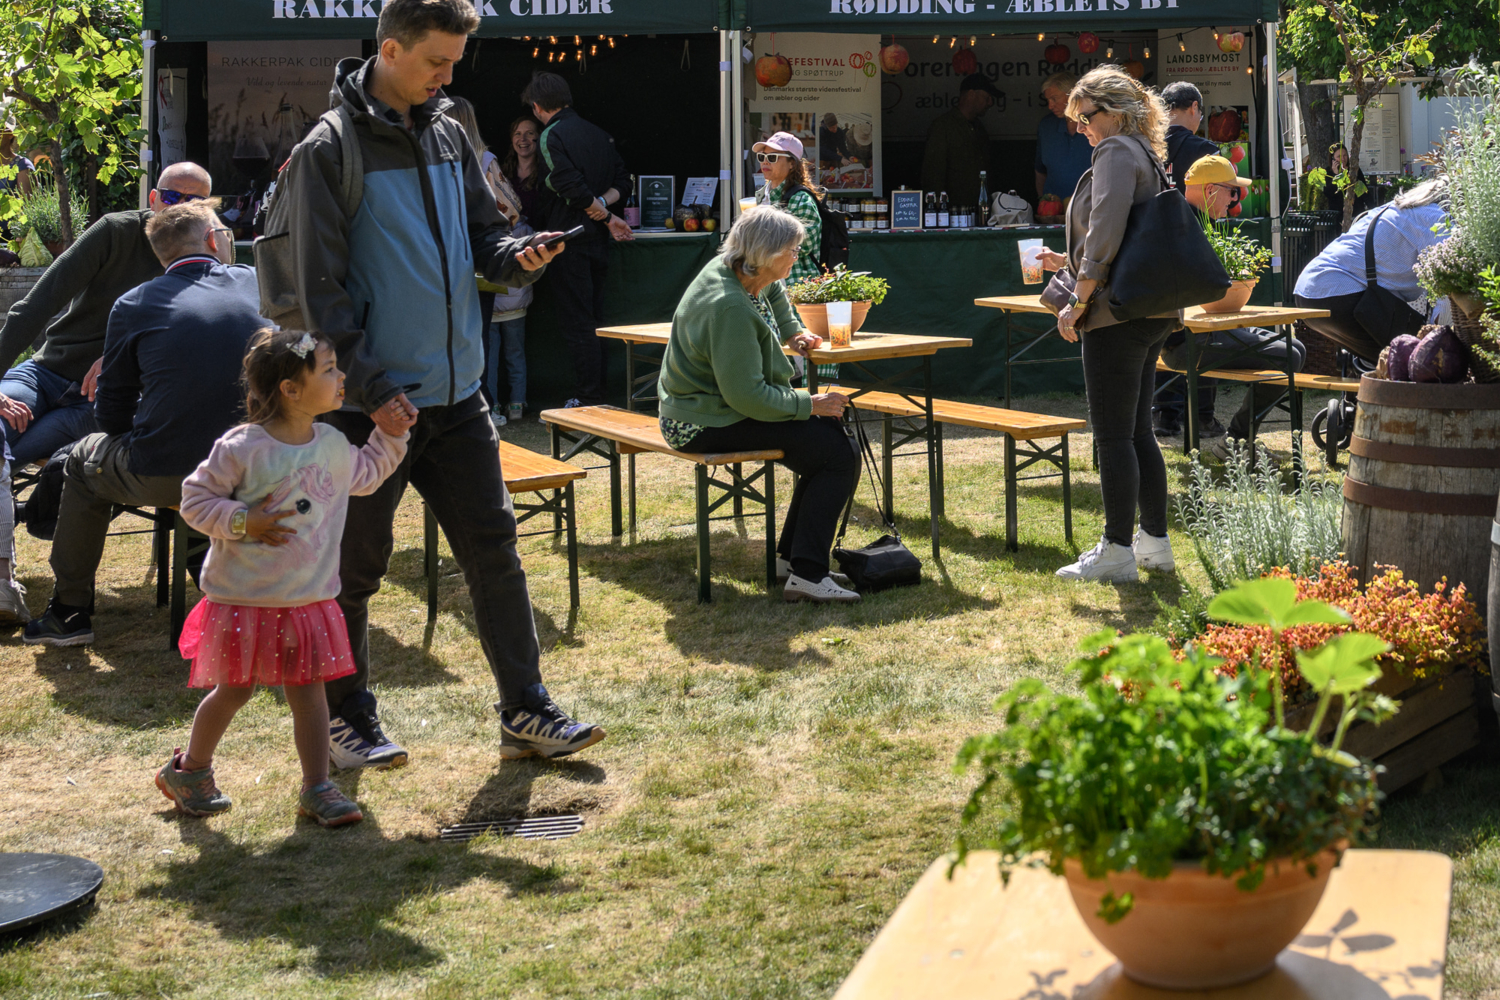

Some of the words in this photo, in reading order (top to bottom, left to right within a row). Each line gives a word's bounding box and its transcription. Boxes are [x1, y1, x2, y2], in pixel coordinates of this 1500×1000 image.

[221, 56, 305, 68] RAKKERPAK
[1166, 53, 1241, 64] LANDSBYMOST
[803, 69, 844, 77] SPØTTRUP
[246, 76, 264, 87] Vild
[265, 80, 274, 88] og
[277, 76, 304, 87] levende
[307, 79, 327, 87] natur
[794, 95, 803, 103] og
